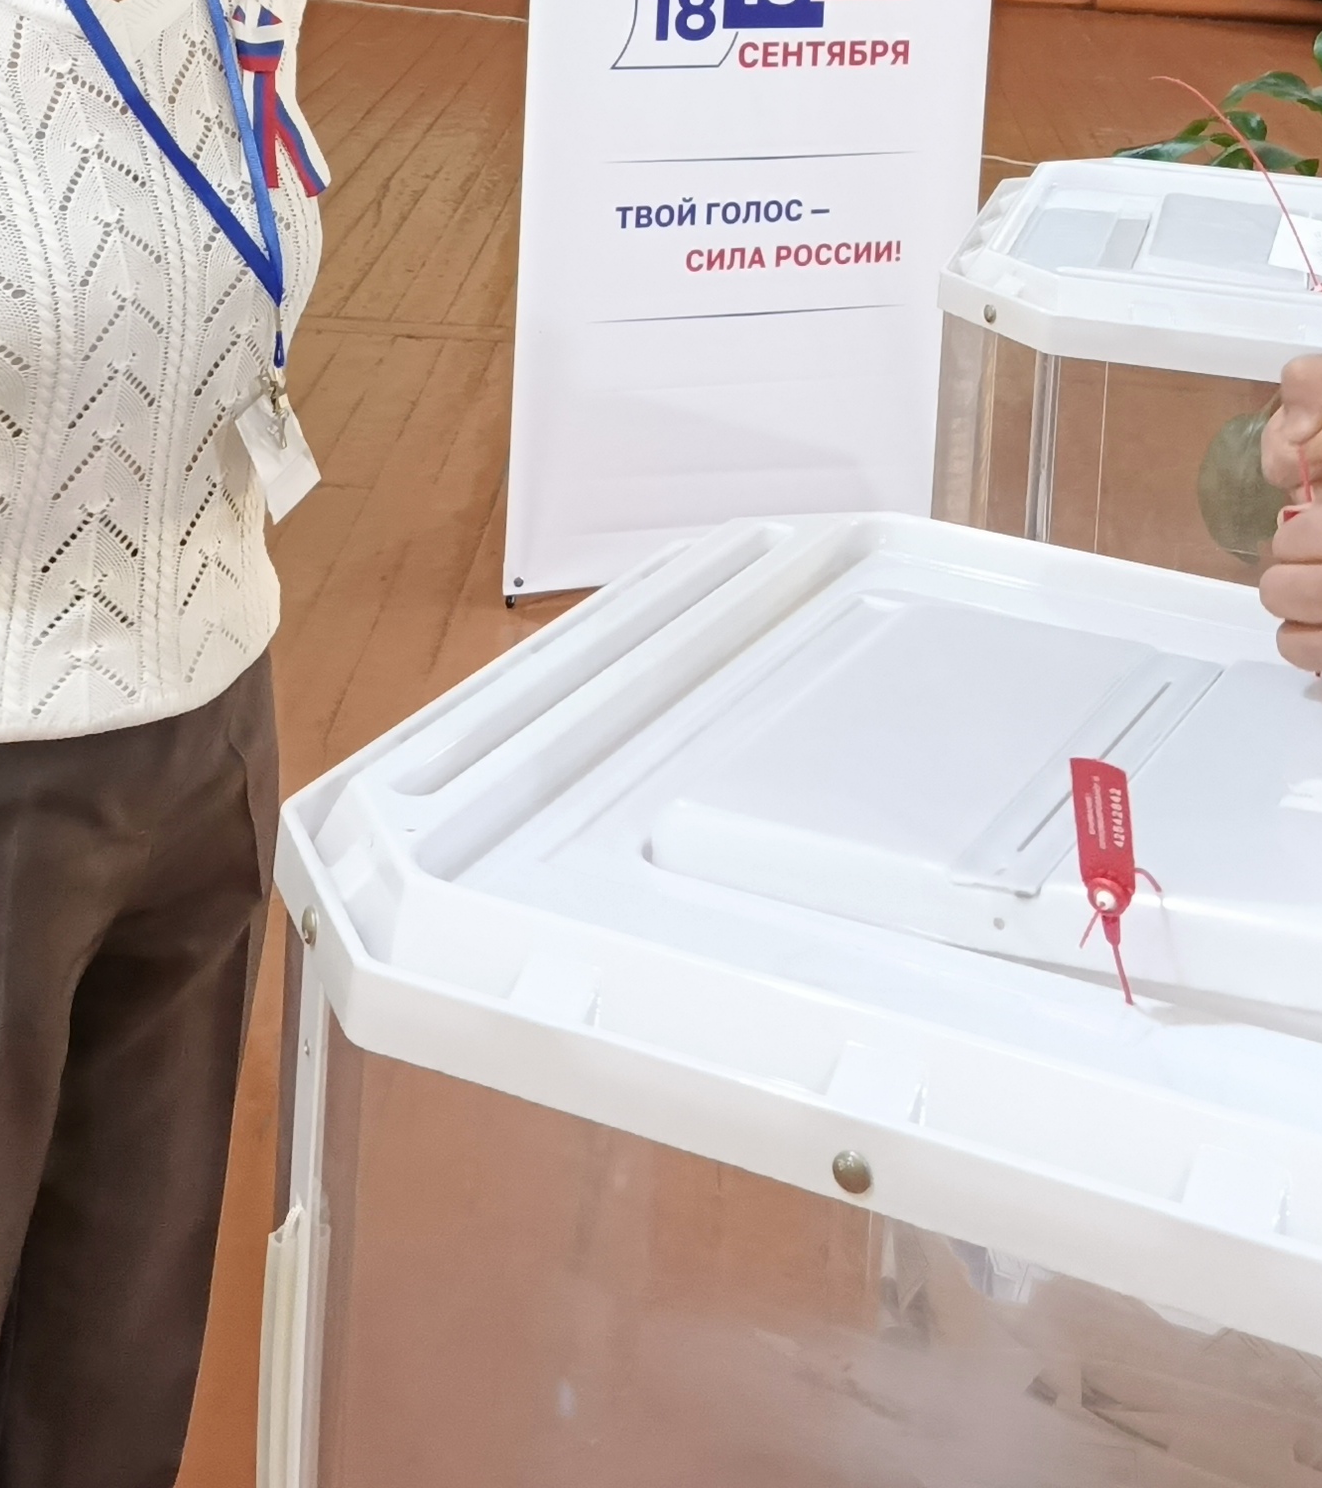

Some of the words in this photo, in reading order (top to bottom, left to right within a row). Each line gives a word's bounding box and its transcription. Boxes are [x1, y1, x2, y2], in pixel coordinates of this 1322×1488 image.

[738, 39, 910, 69] СЕНТЯБРЯ
[615, 197, 697, 230] ТВОЙ
[705, 199, 804, 226] ГОЛОС
[685, 247, 767, 273] СИЛА
[775, 240, 902, 268] РОССИИ!
